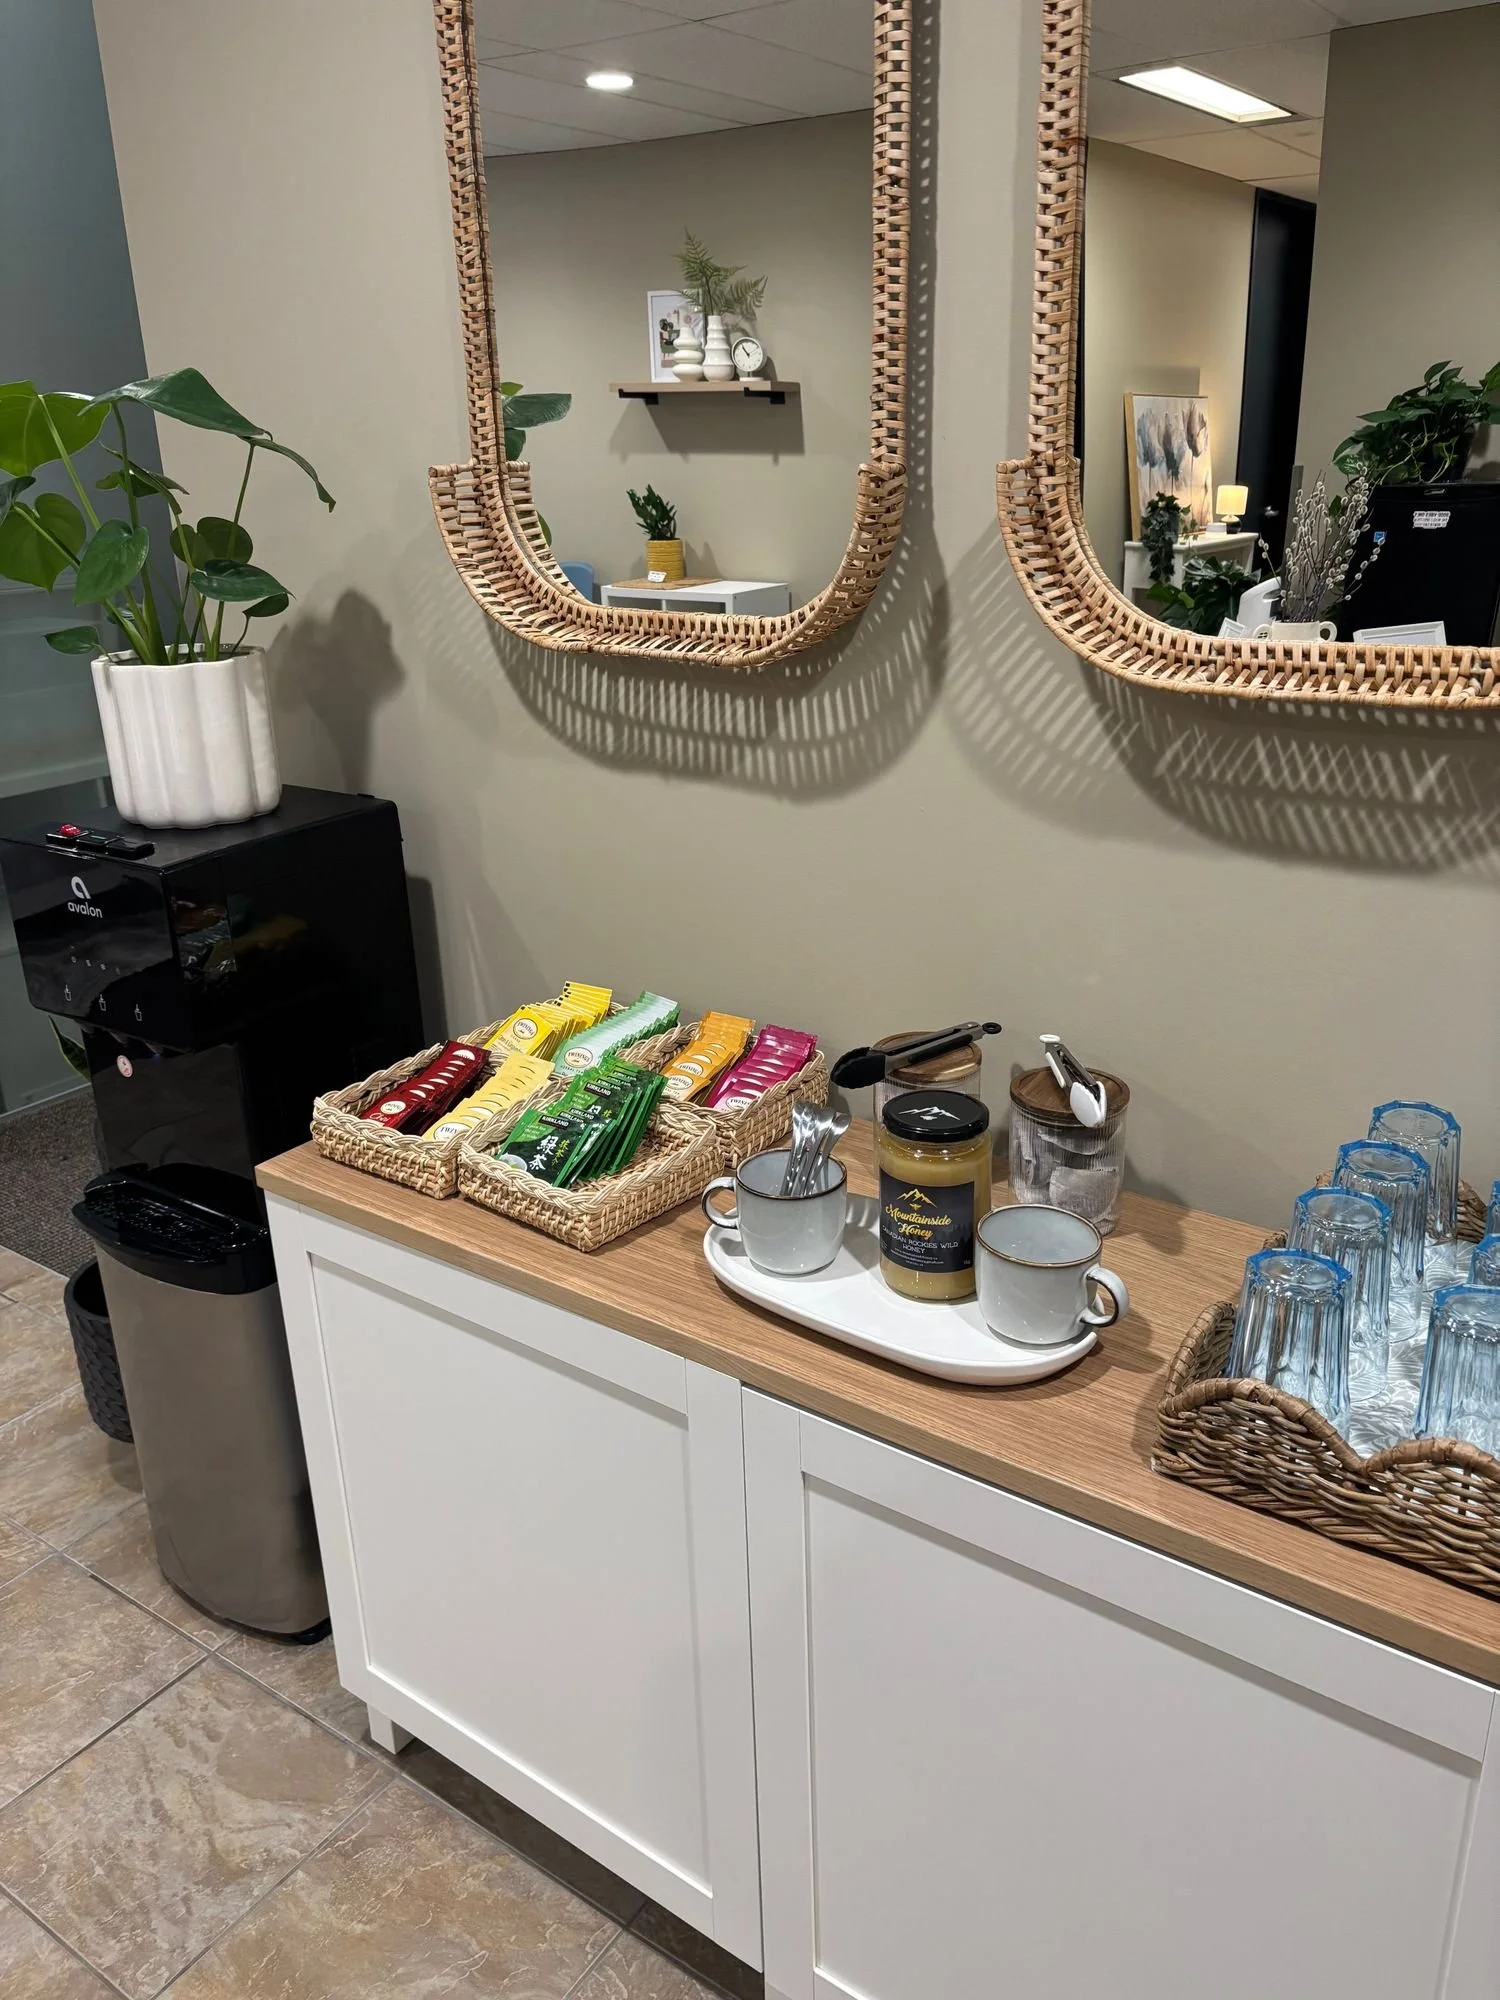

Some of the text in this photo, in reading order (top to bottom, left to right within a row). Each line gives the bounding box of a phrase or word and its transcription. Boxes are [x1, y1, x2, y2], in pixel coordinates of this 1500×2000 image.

[67, 901, 103, 919] avalon
[567, 1051, 590, 1062] TWININGS
[586, 1083, 611, 1096] KIRKLAND
[570, 1108, 595, 1120] KIRKLAND
[541, 1115, 570, 1128] KIRKLAND
[885, 1203, 953, 1226] Mountainside
[897, 1222, 934, 1241] Honey
[902, 1243, 926, 1254] HONEY
[908, 1239, 938, 1249] ROCKIES
[939, 1241, 959, 1249] WILD
